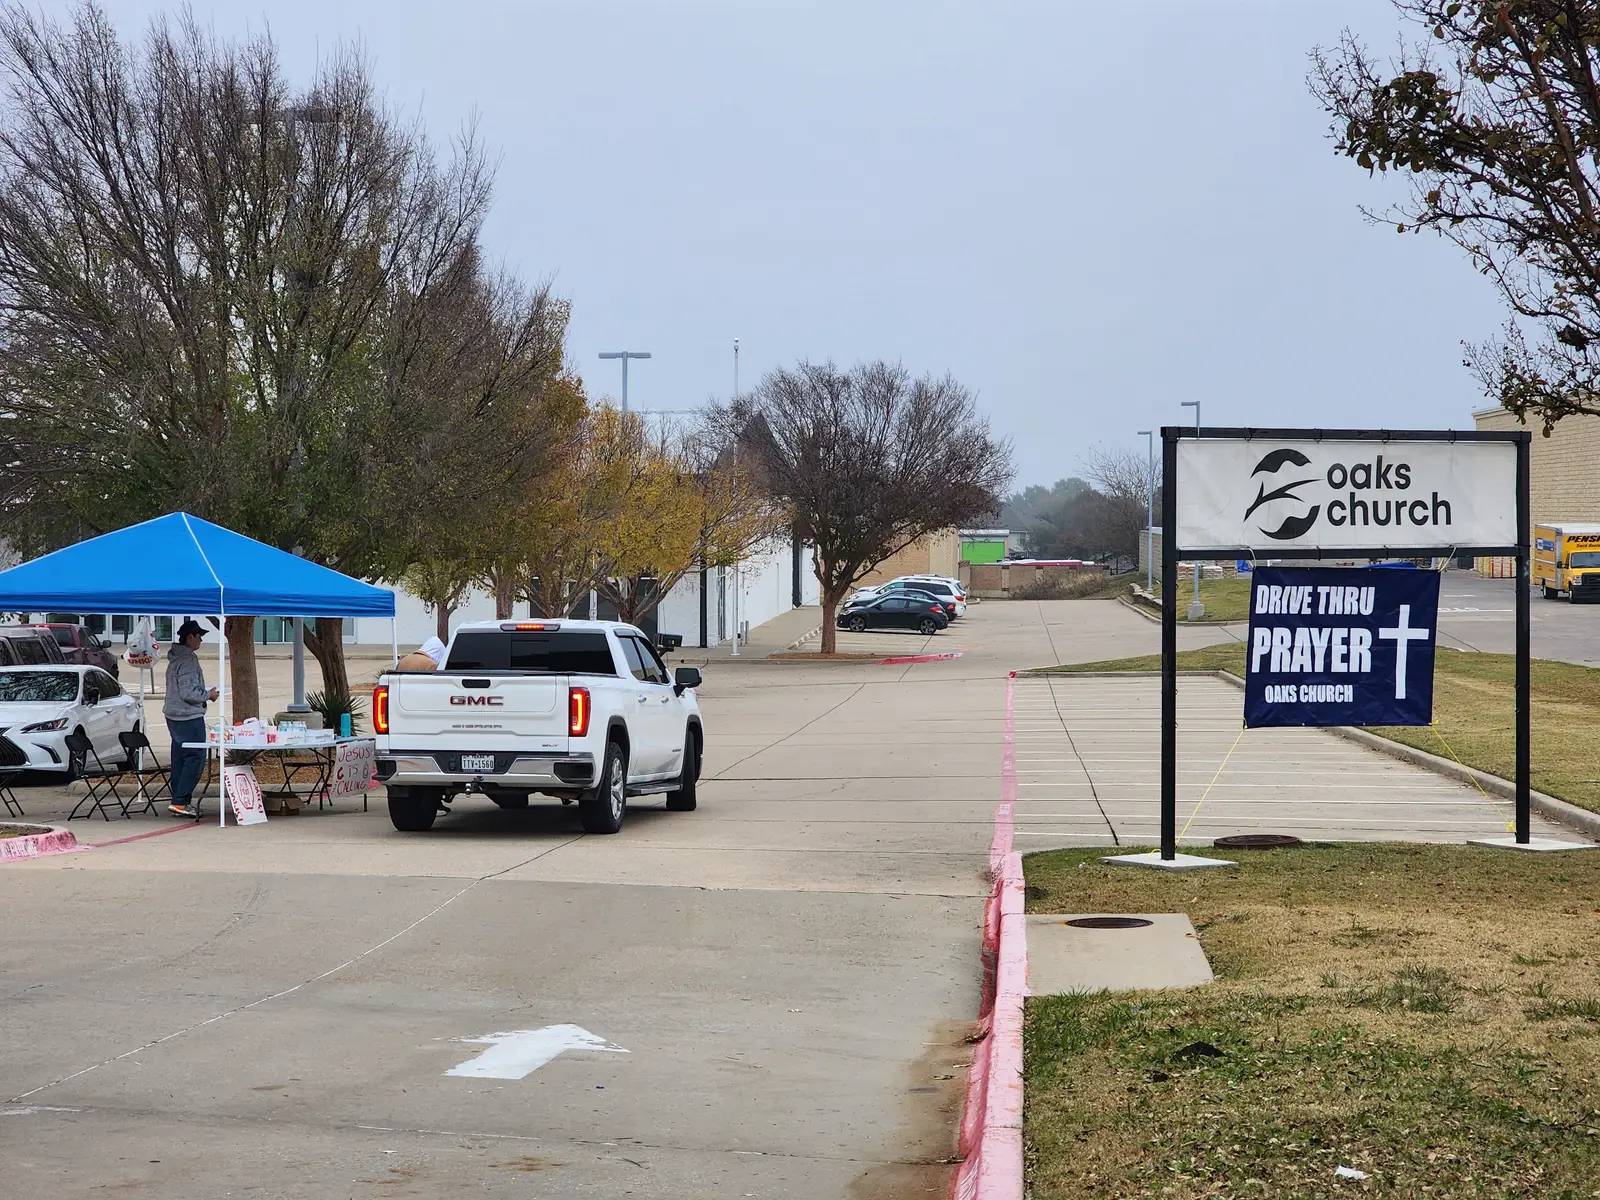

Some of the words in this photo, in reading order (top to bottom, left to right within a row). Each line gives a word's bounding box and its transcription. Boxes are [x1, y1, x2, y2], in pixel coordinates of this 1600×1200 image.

[1327, 455, 1411, 489] oaks
[1327, 492, 1451, 526] church
[1255, 585, 1313, 615] DRIVE
[1317, 586, 1376, 616] THRU
[1251, 627, 1373, 673] PRAYER
[450, 696, 504, 706] GMC
[1265, 685, 1297, 704] OAKS
[1300, 685, 1354, 703] CHURCH
